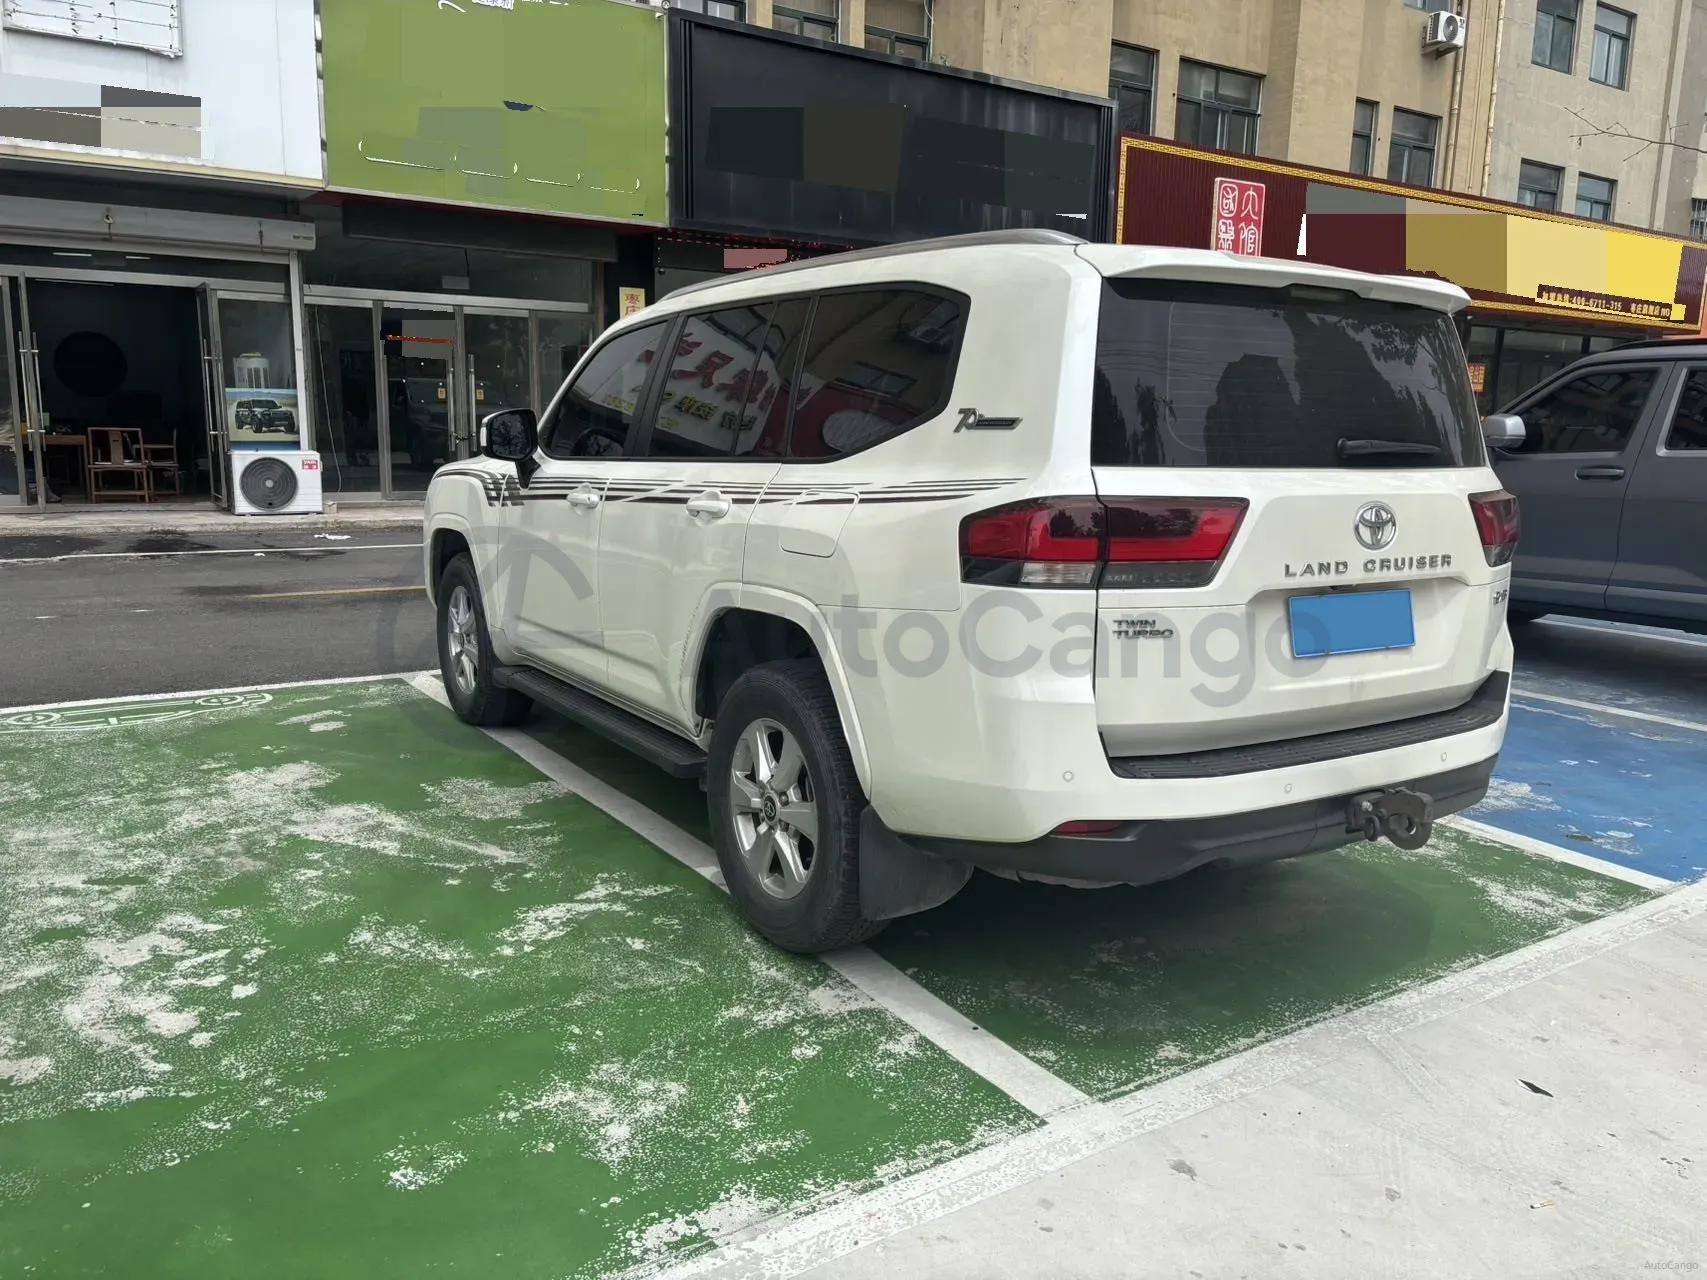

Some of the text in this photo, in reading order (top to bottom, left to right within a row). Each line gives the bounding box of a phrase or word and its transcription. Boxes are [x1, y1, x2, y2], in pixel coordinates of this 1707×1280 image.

[1284, 554, 1452, 578] LAND CRUISER
[1112, 619, 1156, 629] TWIN
[1112, 628, 1174, 640] TURBO
